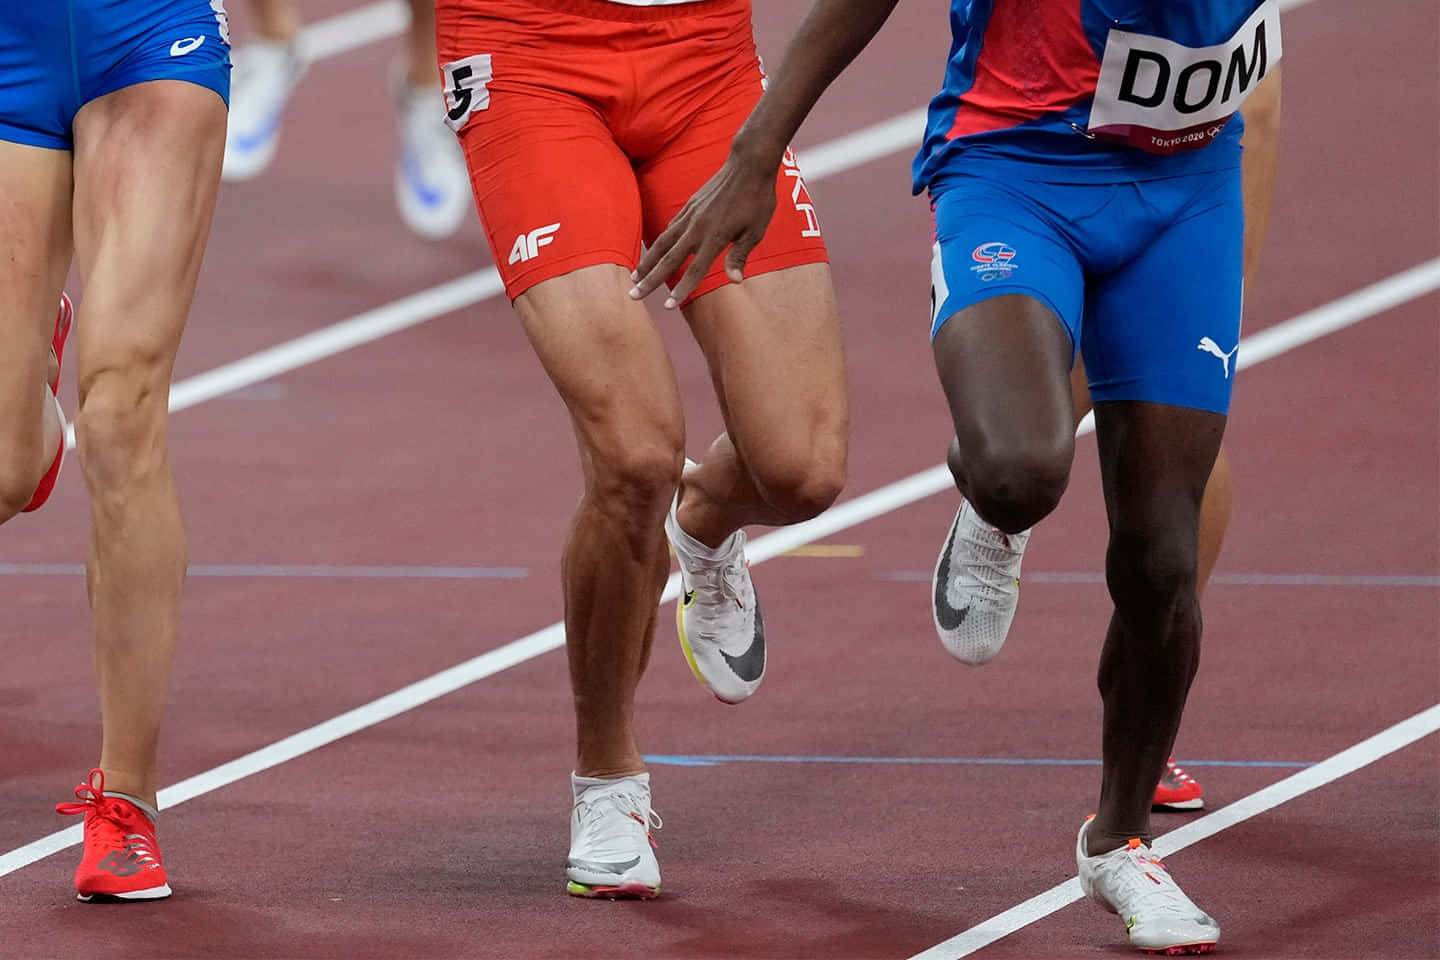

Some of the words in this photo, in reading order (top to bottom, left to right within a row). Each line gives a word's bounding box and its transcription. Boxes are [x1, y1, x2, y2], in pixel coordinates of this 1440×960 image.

[1118, 19, 1268, 114] DOM
[447, 65, 473, 121] 5
[1151, 135, 1181, 147] TOKYO
[1182, 131, 1205, 143] 2020
[509, 223, 560, 265] 4F
